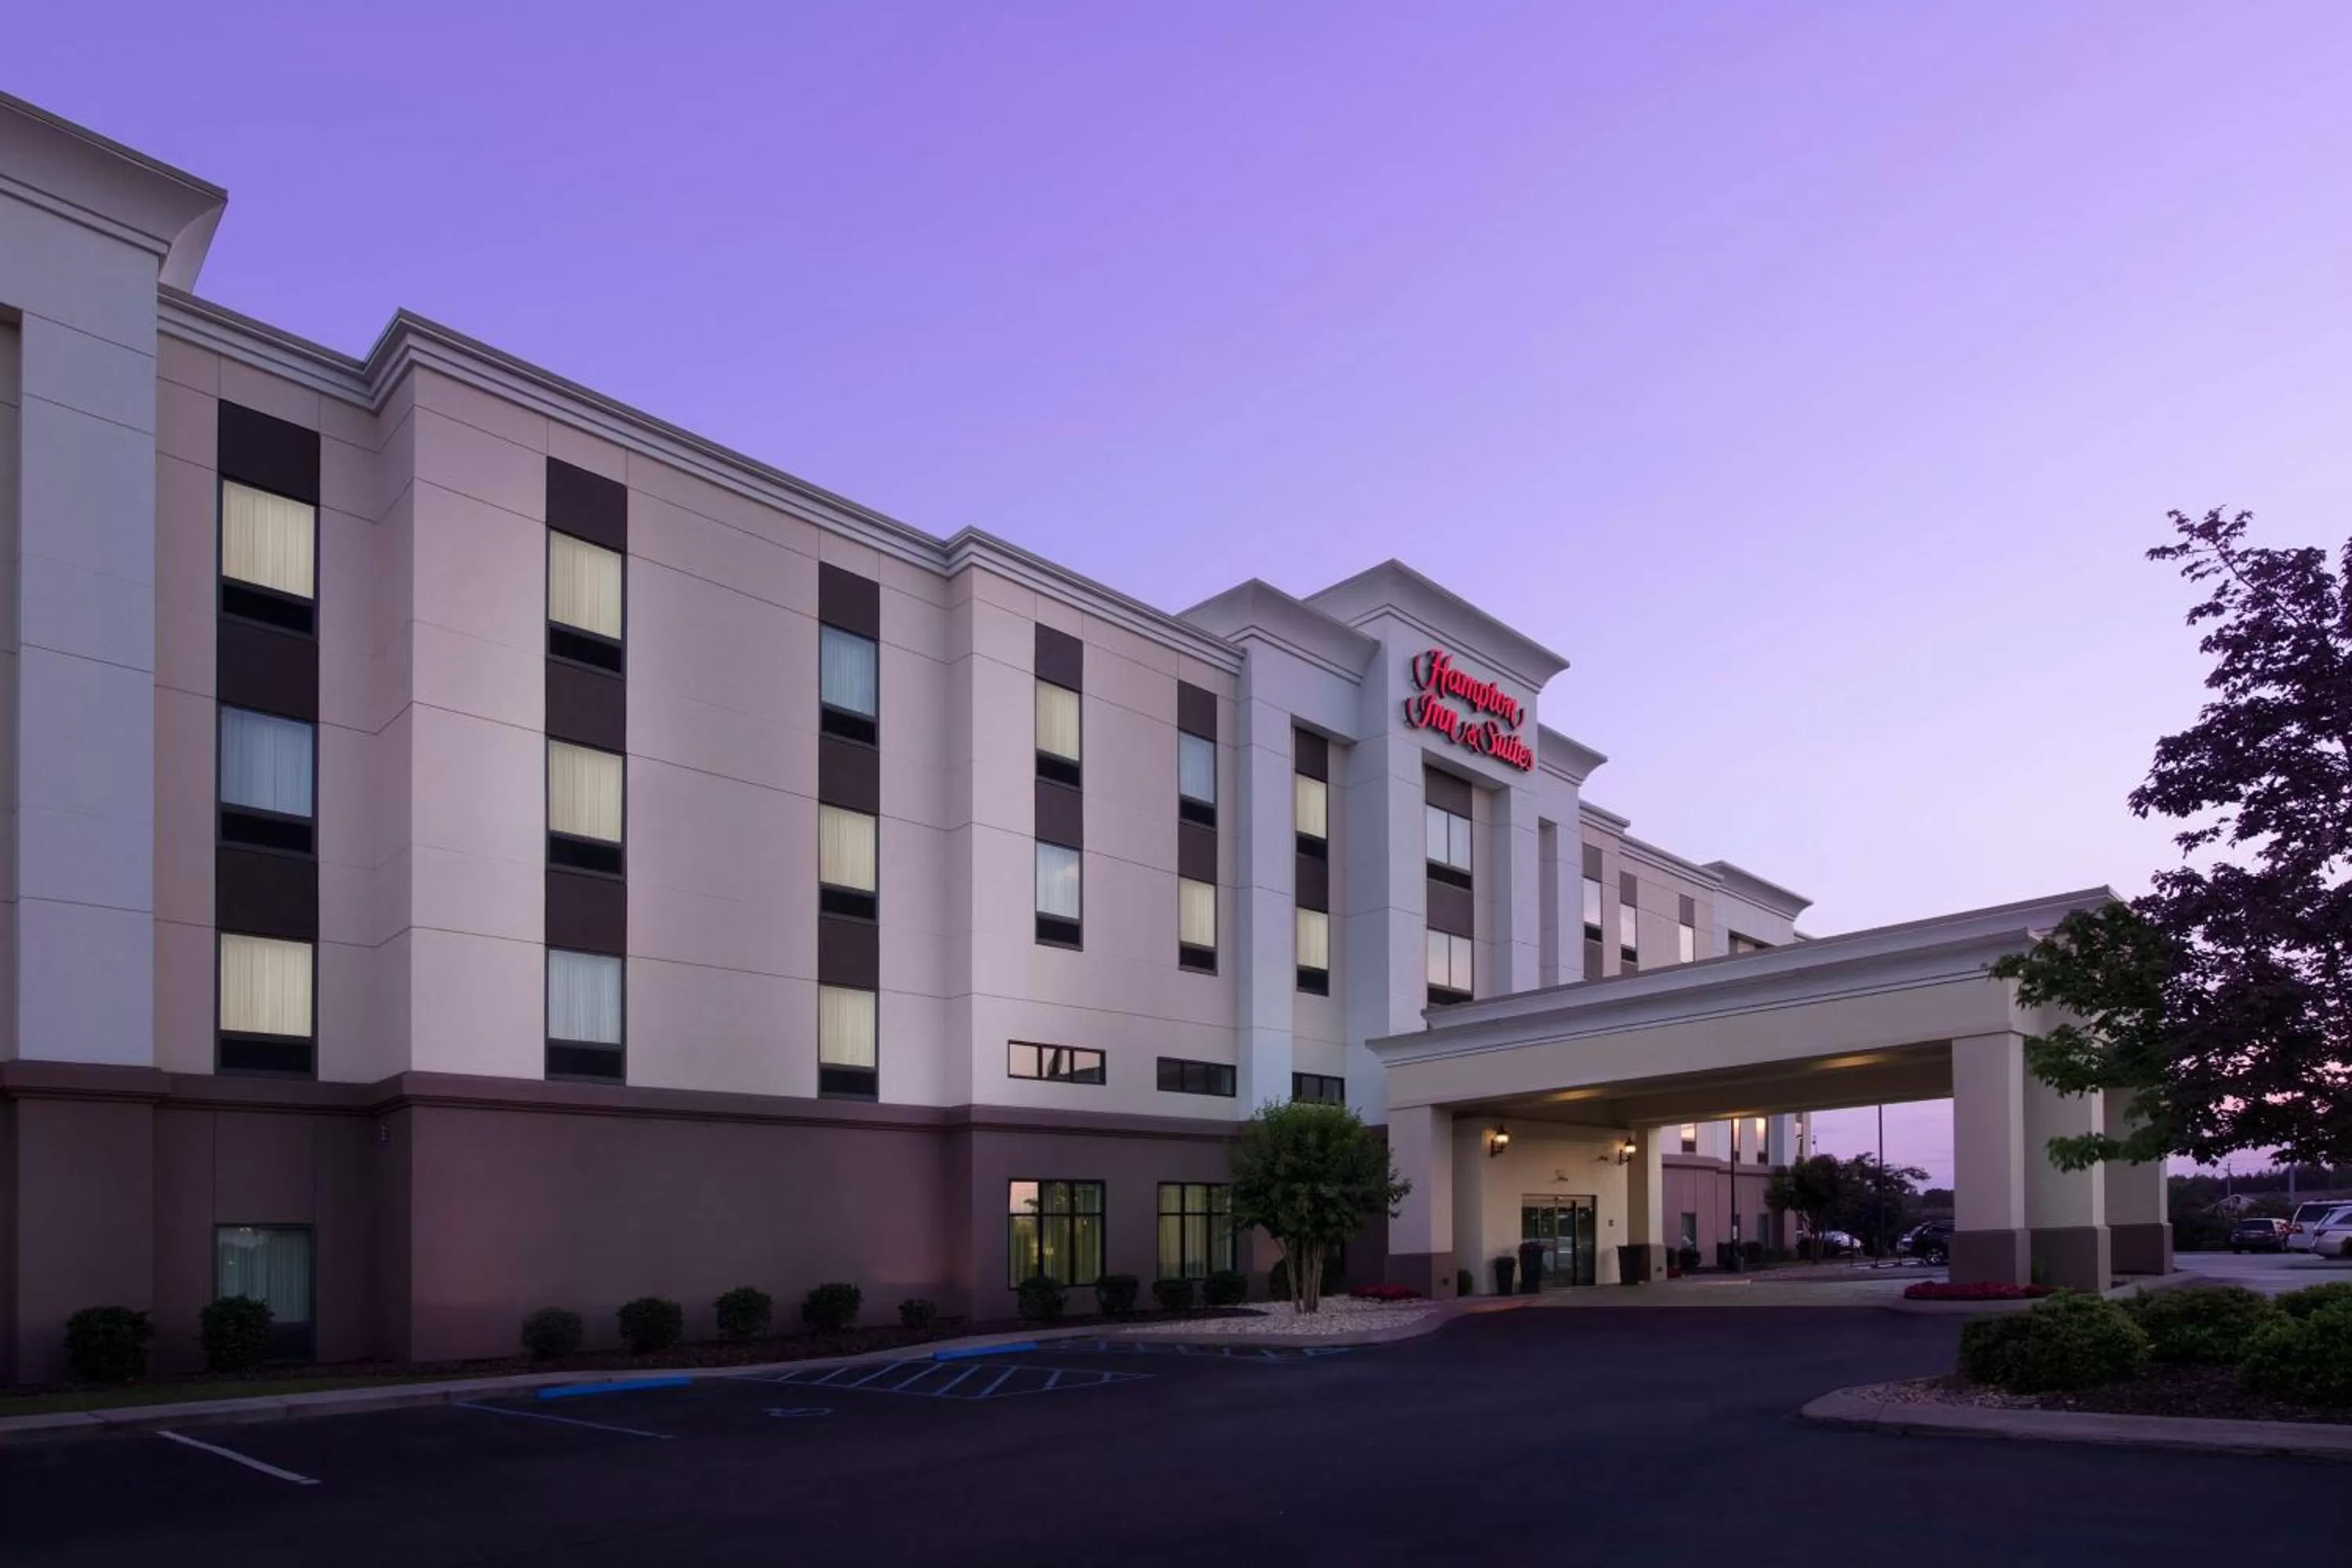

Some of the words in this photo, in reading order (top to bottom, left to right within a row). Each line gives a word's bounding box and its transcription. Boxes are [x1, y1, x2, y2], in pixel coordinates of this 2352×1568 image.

[1413, 648, 1525, 730] Hampton
[1405, 692, 1466, 743] Inn
[1465, 722, 1481, 753] &
[1477, 718, 1535, 771] Suites
